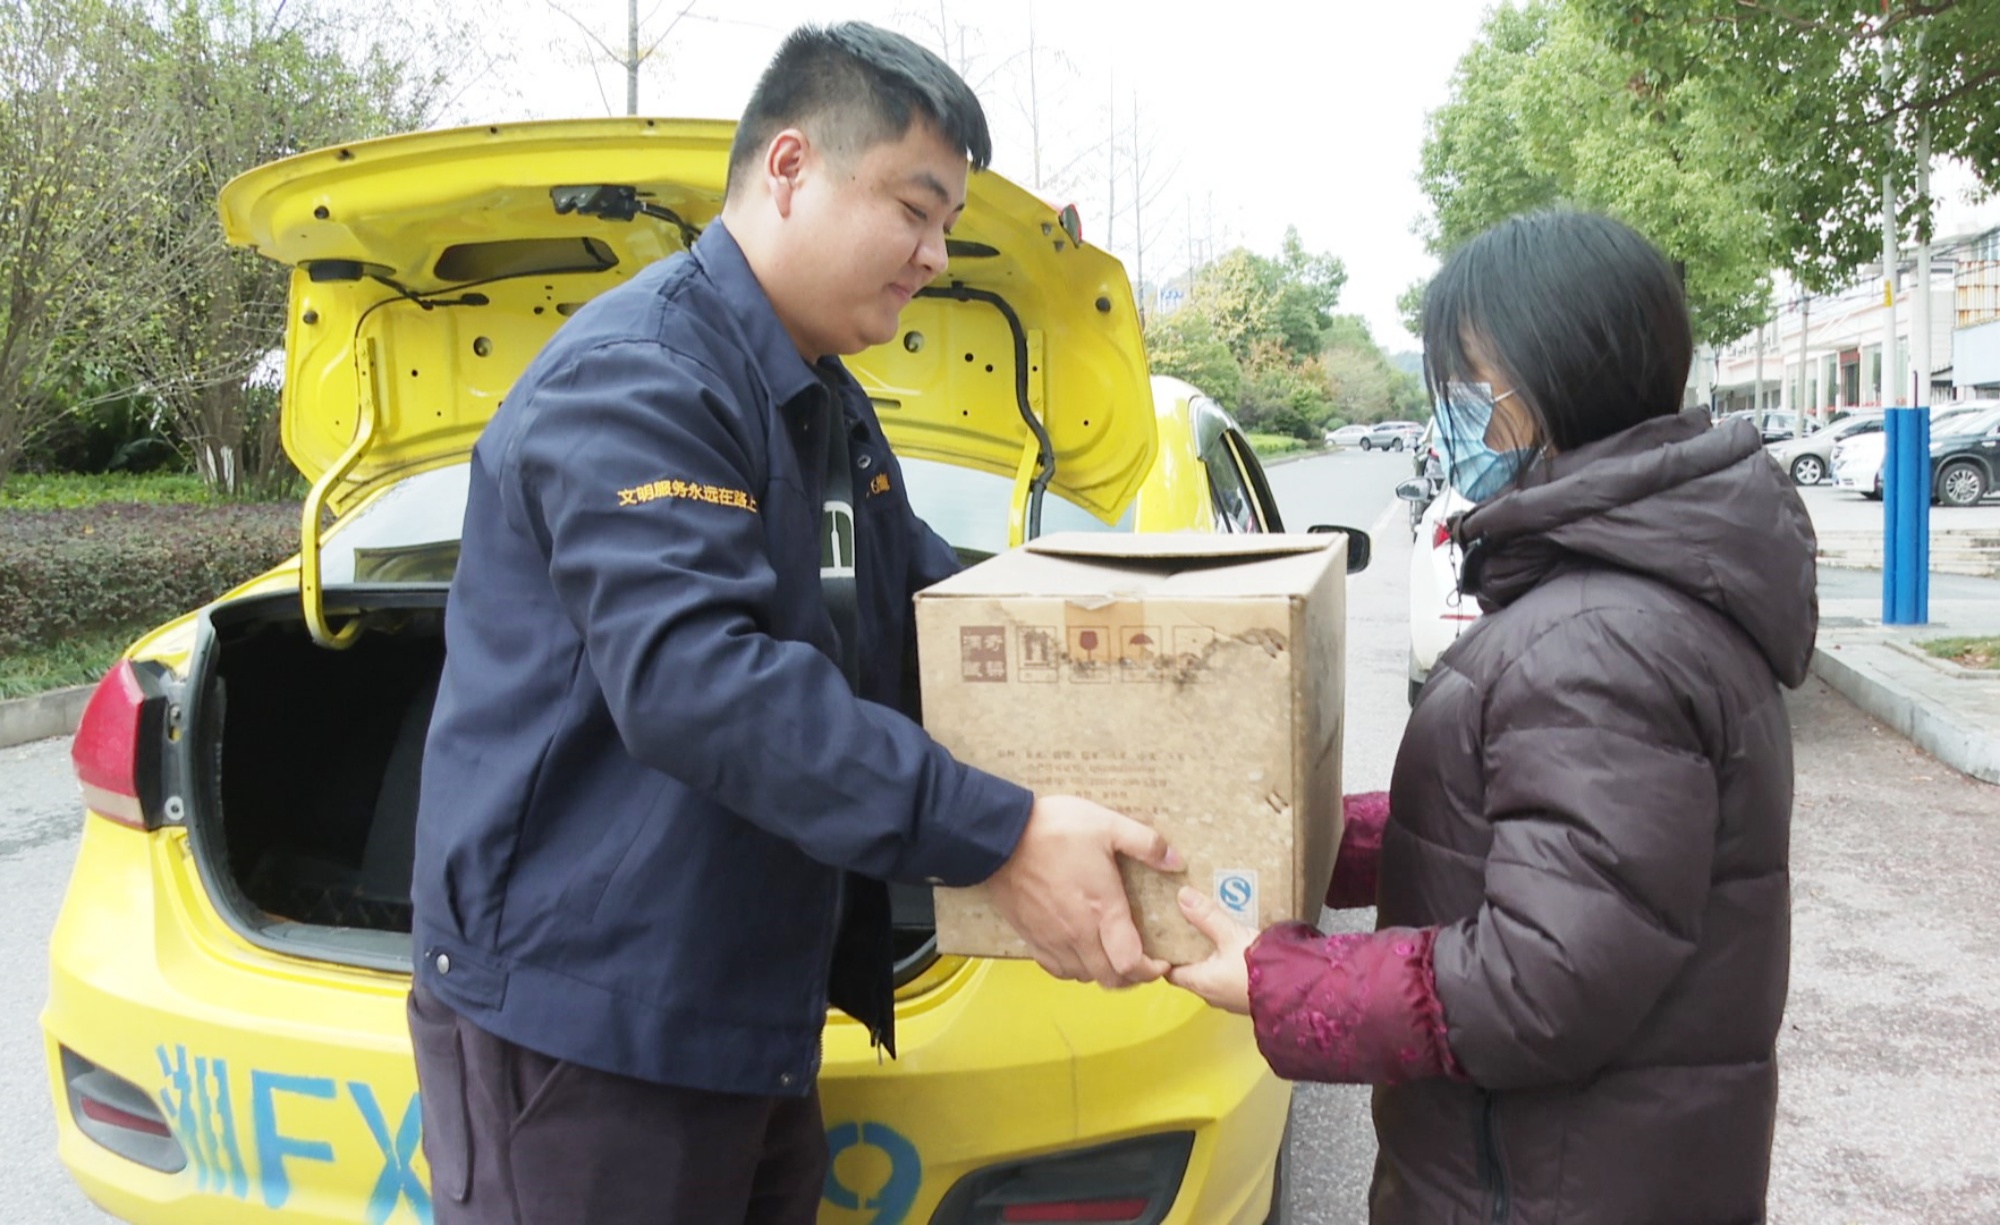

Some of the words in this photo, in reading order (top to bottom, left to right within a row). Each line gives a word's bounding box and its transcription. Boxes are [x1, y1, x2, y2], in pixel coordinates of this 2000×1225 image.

[617, 479, 757, 513] 文明服务永远在路上
